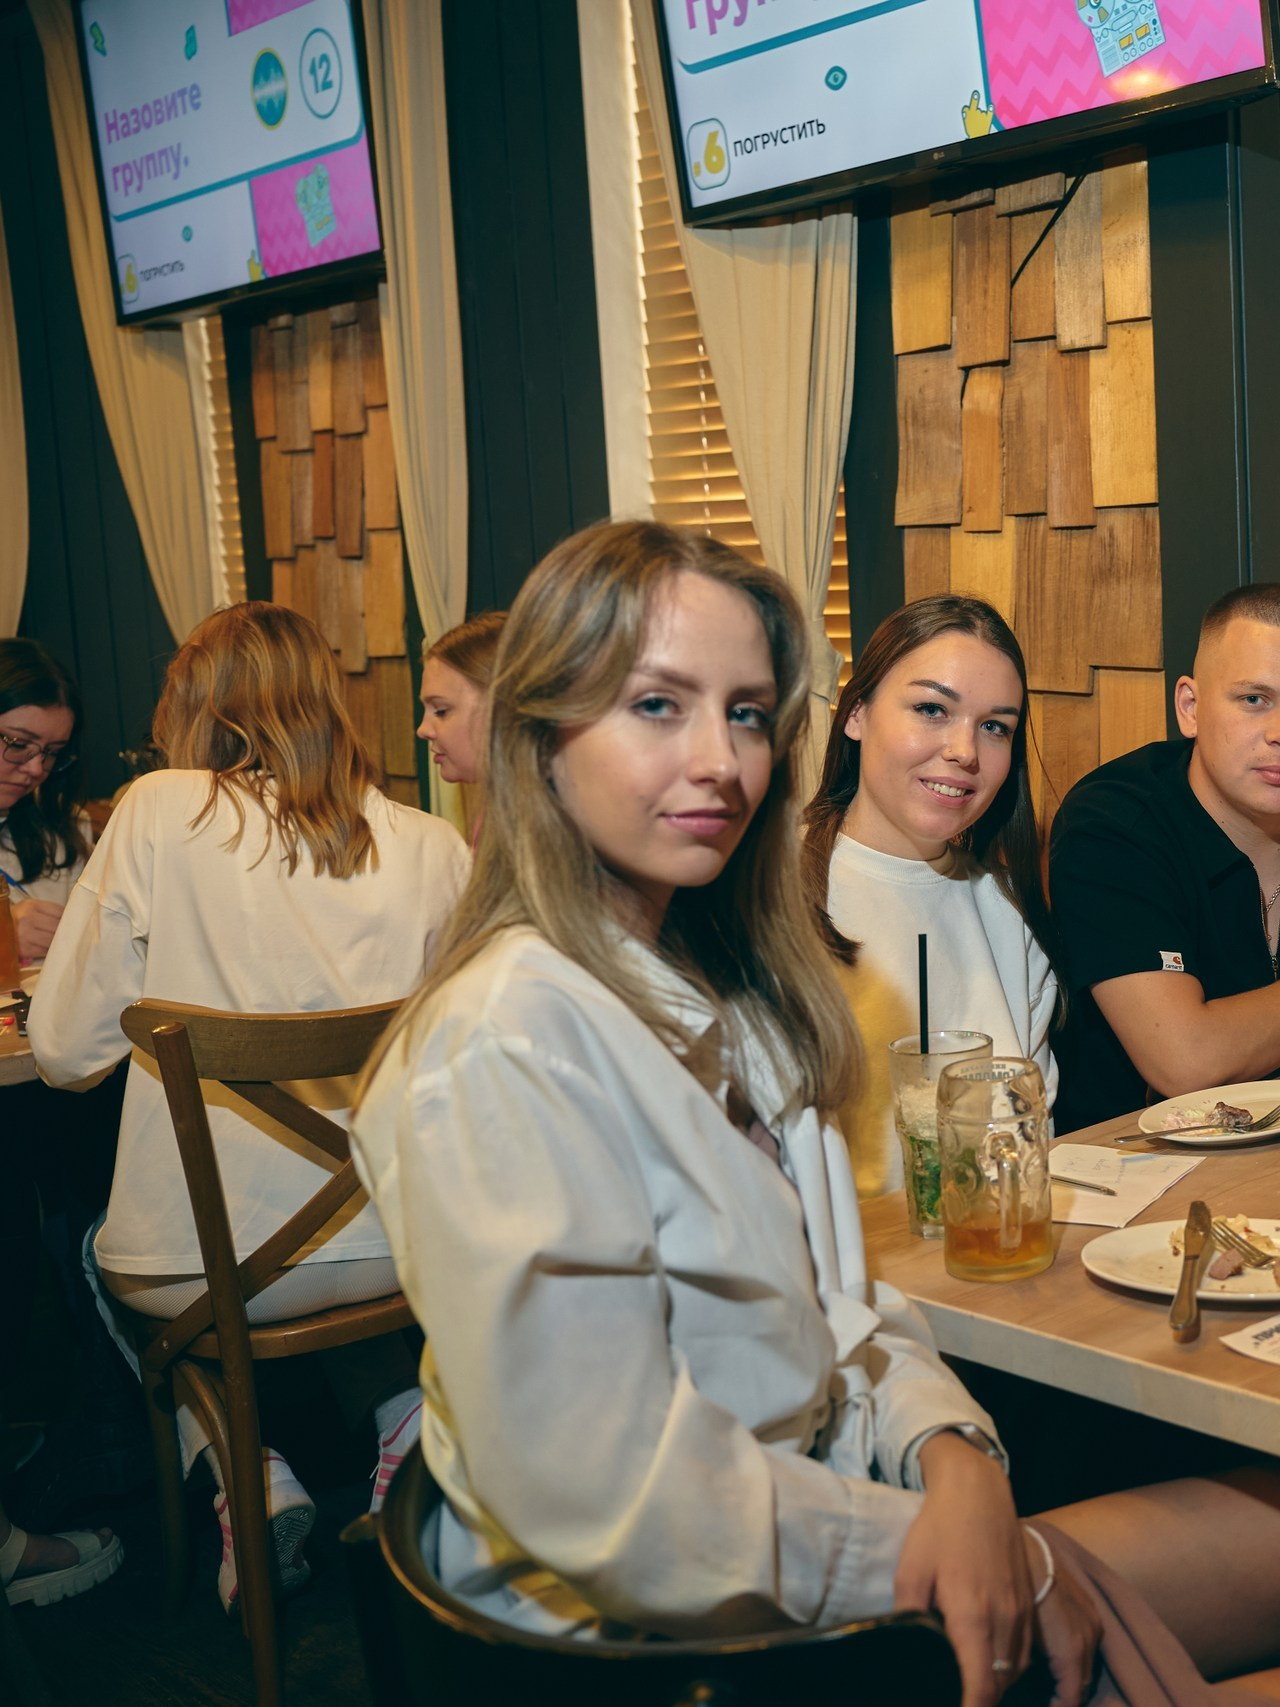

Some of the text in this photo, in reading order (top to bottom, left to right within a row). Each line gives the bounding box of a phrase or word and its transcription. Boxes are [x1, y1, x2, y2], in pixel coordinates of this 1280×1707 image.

[308, 53, 333, 95] 12
[104, 82, 202, 145] Назовите
[733, 118, 827, 158] ПОГРУСТИТЬ
[111, 142, 190, 198] группу.
